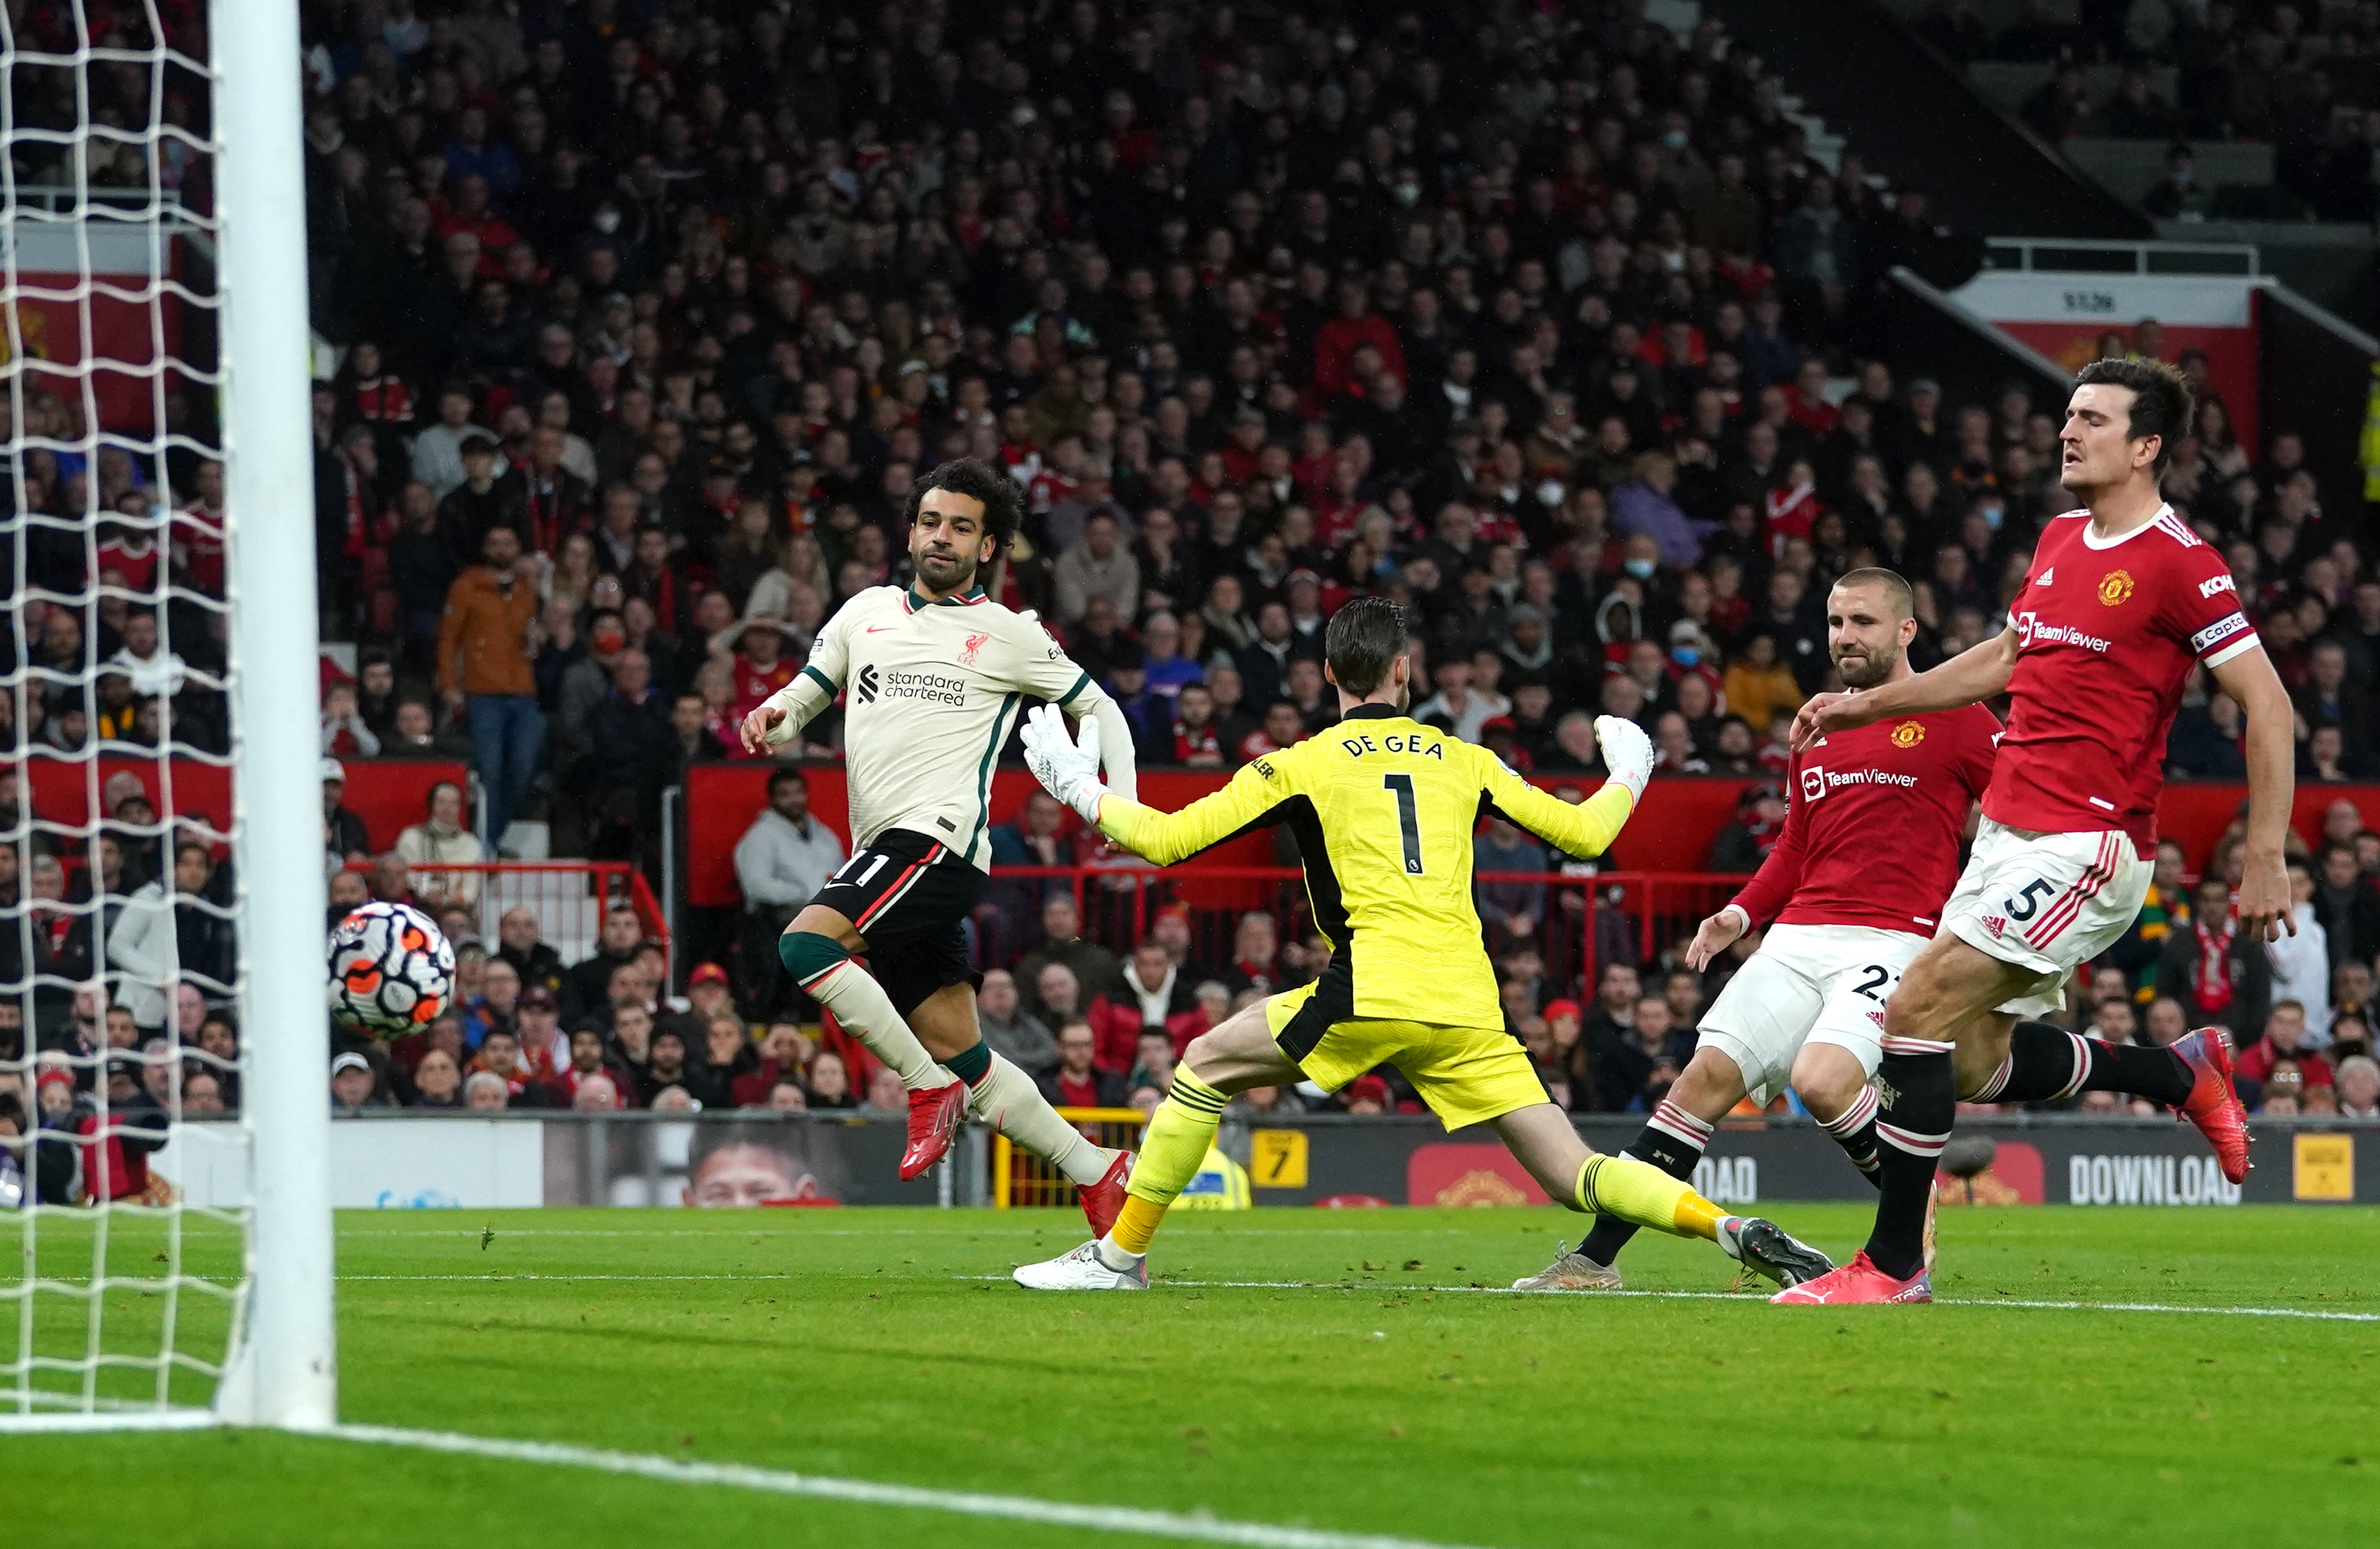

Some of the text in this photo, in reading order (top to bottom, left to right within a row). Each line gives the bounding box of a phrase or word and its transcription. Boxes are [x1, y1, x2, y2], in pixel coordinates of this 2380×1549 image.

[2198, 574, 2236, 599] KOH
[2034, 622, 2112, 653] TeamViewer
[2205, 617, 2244, 640] Capta
[887, 671, 965, 693] standard
[885, 685, 965, 707] chartered
[1342, 735, 1442, 760] DE GEA
[1251, 759, 1274, 780] LER
[1825, 769, 1918, 788] TeamViewer
[1383, 773, 1424, 874] 1
[833, 849, 890, 887] 11
[2003, 877, 2056, 921] 5
[1981, 916, 2002, 940] adidas
[1851, 965, 1901, 1010] 2
[1692, 1156, 1757, 1203] OAD
